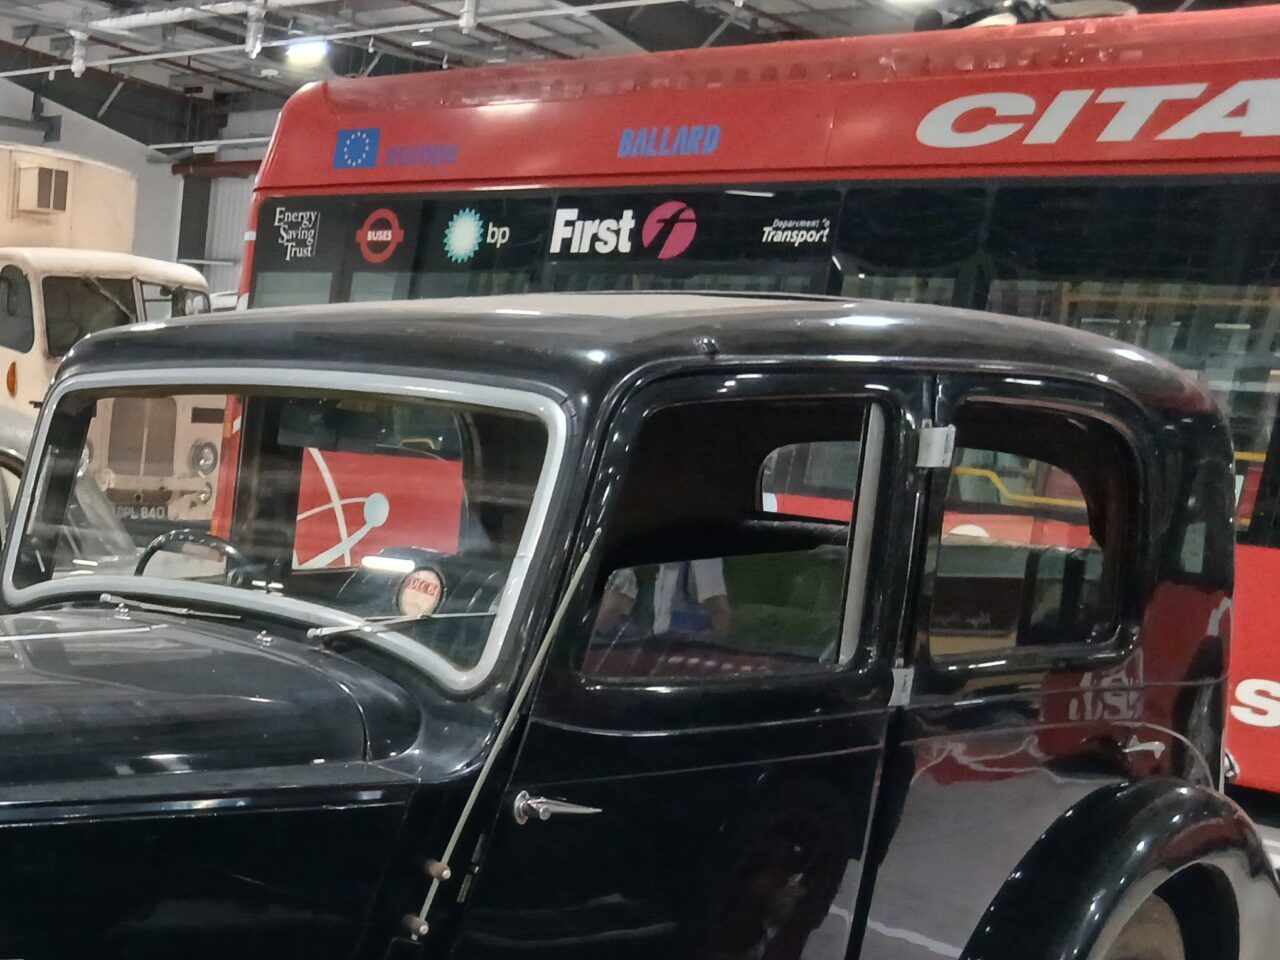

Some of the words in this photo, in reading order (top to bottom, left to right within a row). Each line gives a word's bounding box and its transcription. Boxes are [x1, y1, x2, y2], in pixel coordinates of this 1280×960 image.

[916, 78, 1280, 148] CITA
[617, 124, 721, 158] BALLARD
[273, 207, 318, 229] Energy
[278, 224, 316, 246] Saving
[366, 229, 393, 242] BUSES
[486, 222, 511, 248] bp
[549, 208, 636, 254] First
[761, 226, 830, 248] Transport
[283, 241, 313, 261] Trust
